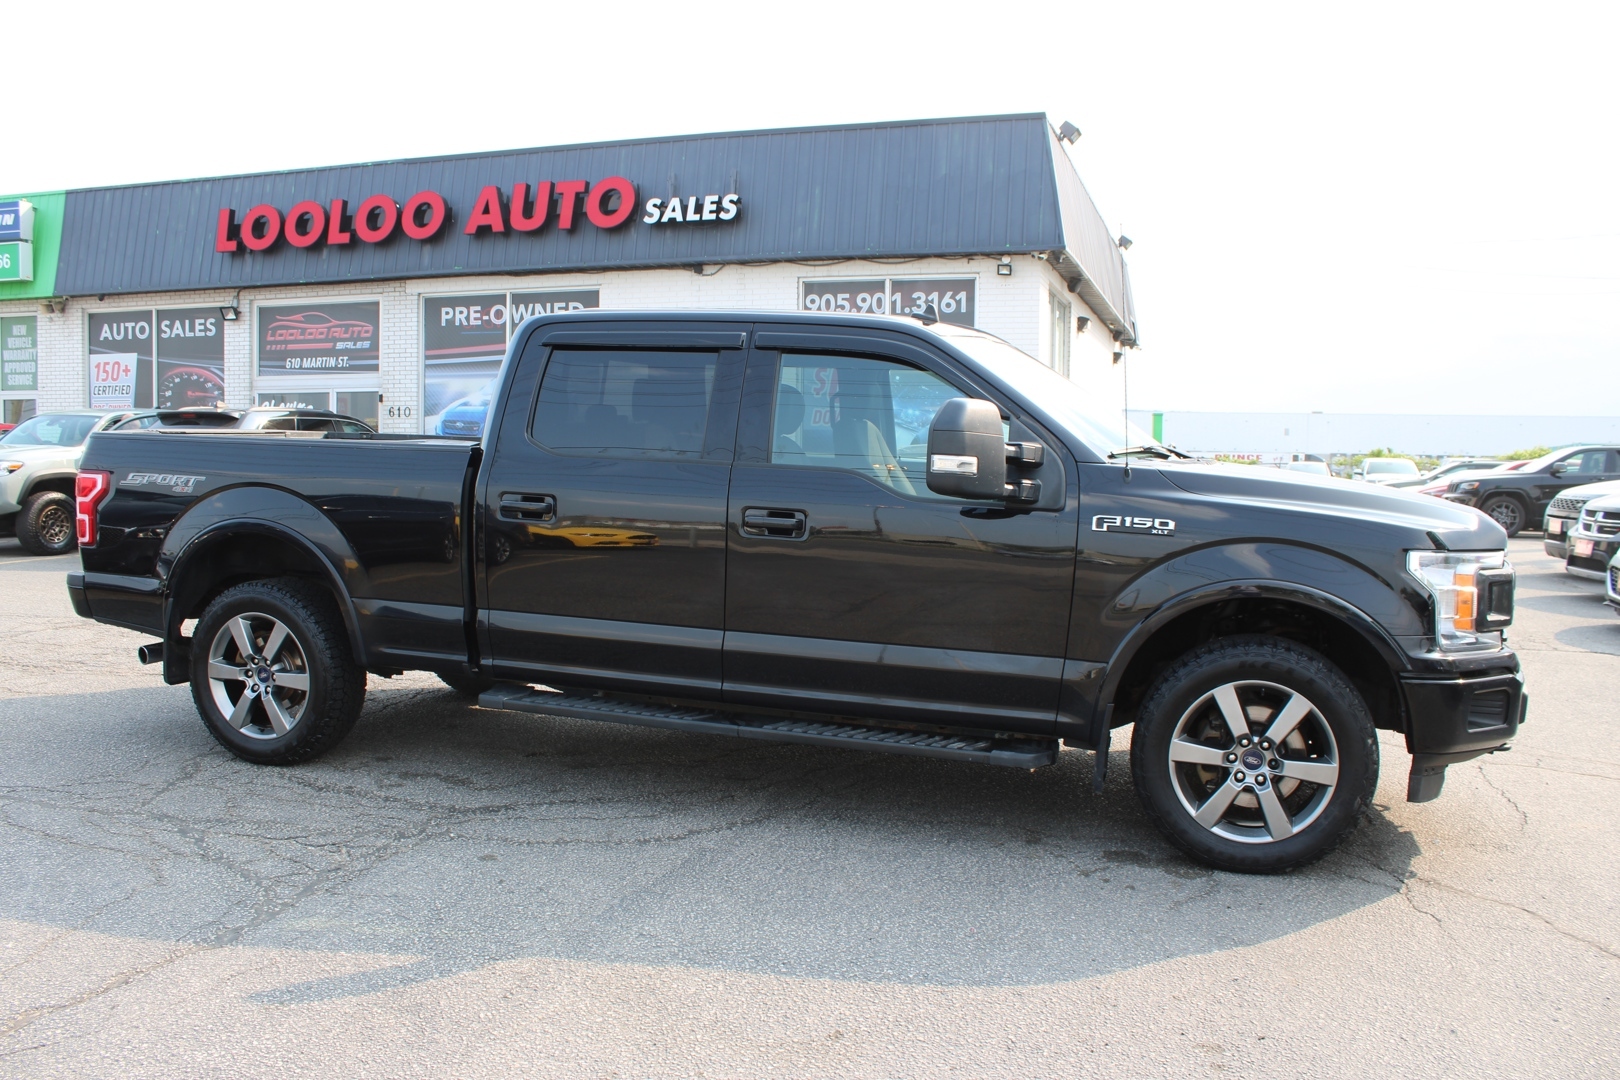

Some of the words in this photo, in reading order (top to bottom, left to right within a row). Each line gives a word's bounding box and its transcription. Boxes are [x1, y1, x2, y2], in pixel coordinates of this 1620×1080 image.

[216, 190, 445, 253] LOOLOO
[463, 176, 638, 236] AUTO
[642, 193, 739, 224] SALES
[805, 291, 967, 313] 905.901.3161
[12, 324, 27, 336] NEW
[100, 321, 150, 341] AUTO
[160, 318, 216, 338] SALES
[266, 328, 328, 341] LOOLOO
[328, 326, 373, 339] AUTO
[7, 337, 32, 348] VEHICLE
[335, 341, 371, 349] SALES
[3, 350, 37, 361] WARRANTY
[4, 362, 36, 373] APPROVED
[286, 357, 300, 369] 610
[302, 356, 336, 368] MARTIN
[338, 356, 349, 368] ST.
[94, 361, 131, 382] 150+
[7, 374, 33, 386] SERVICE
[92, 384, 131, 396] CERTIFIED
[388, 406, 411, 418] 610
[119, 472, 206, 487] SPORT
